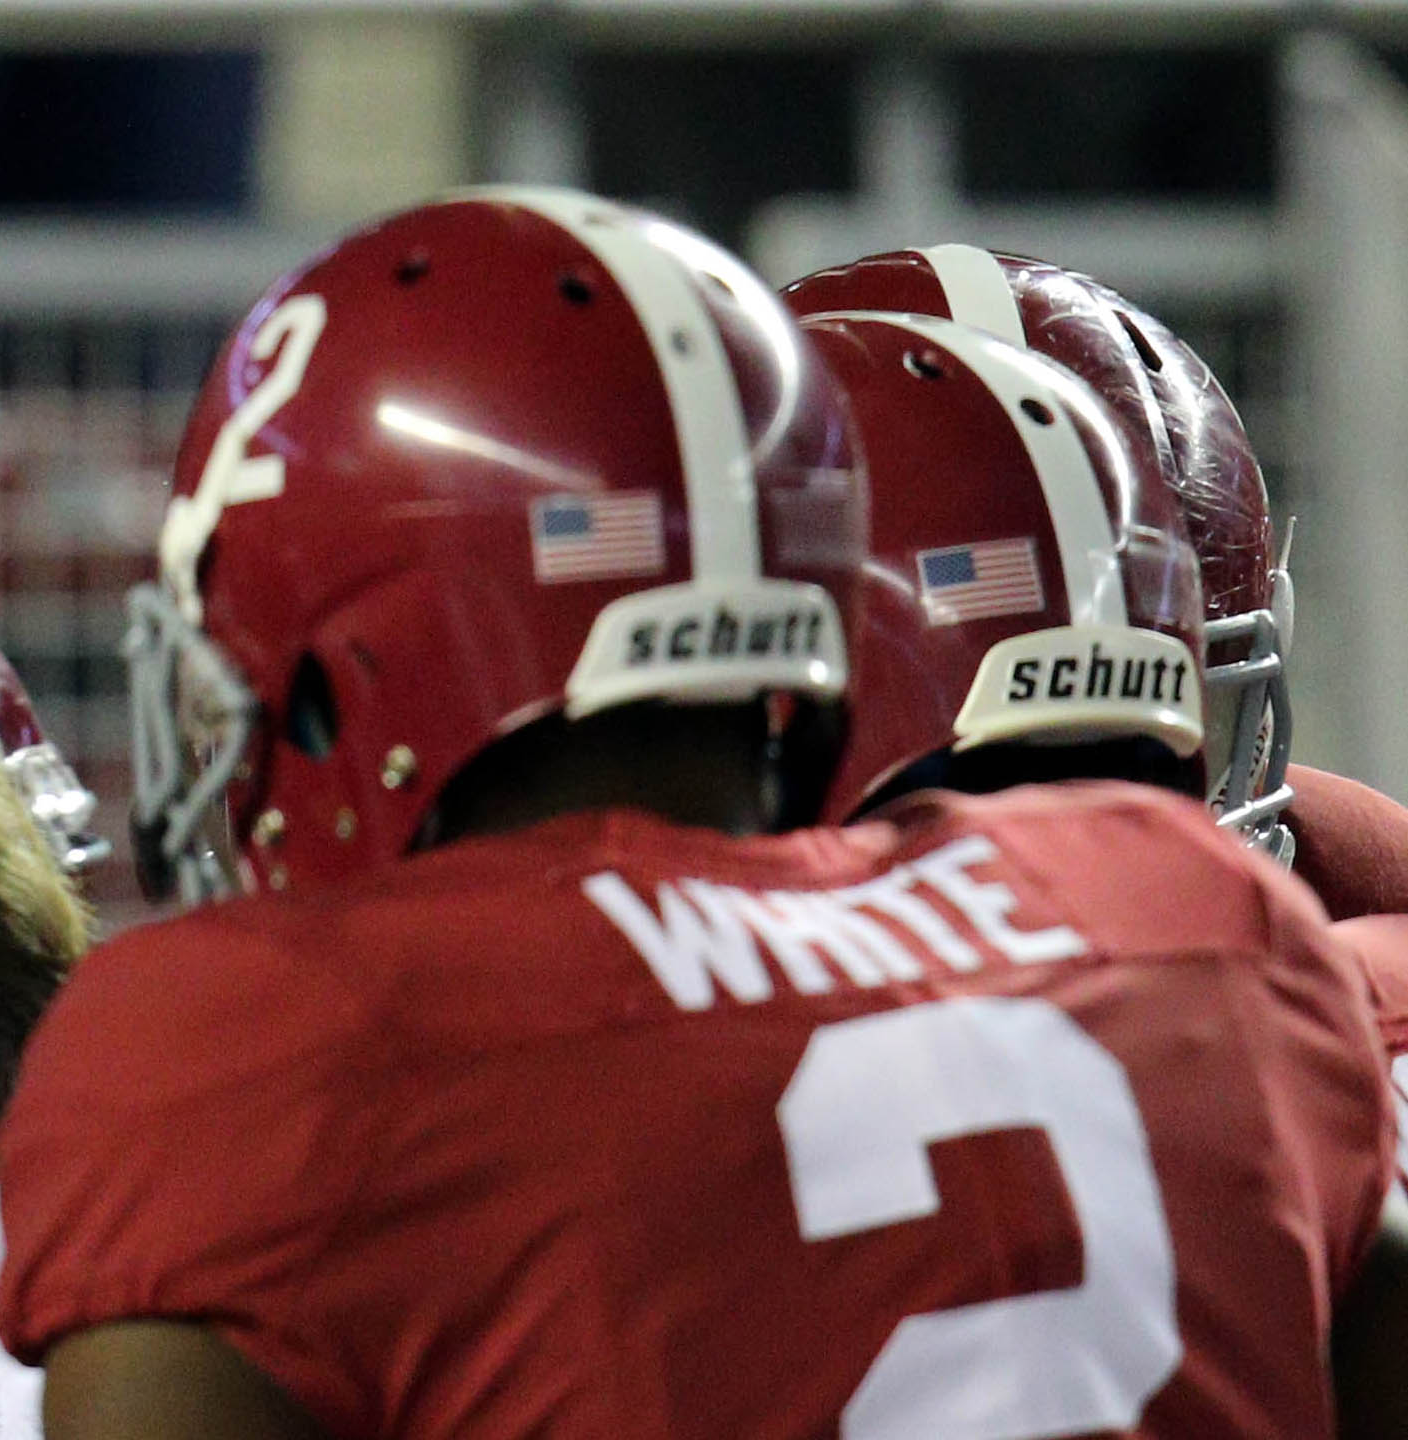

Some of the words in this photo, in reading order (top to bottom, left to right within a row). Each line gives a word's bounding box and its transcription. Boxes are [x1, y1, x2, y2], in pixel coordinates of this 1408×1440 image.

[217, 293, 327, 509] 2
[626, 606, 824, 667] schutt
[1008, 643, 1188, 704] schutt
[584, 839, 1088, 1012] WHITE
